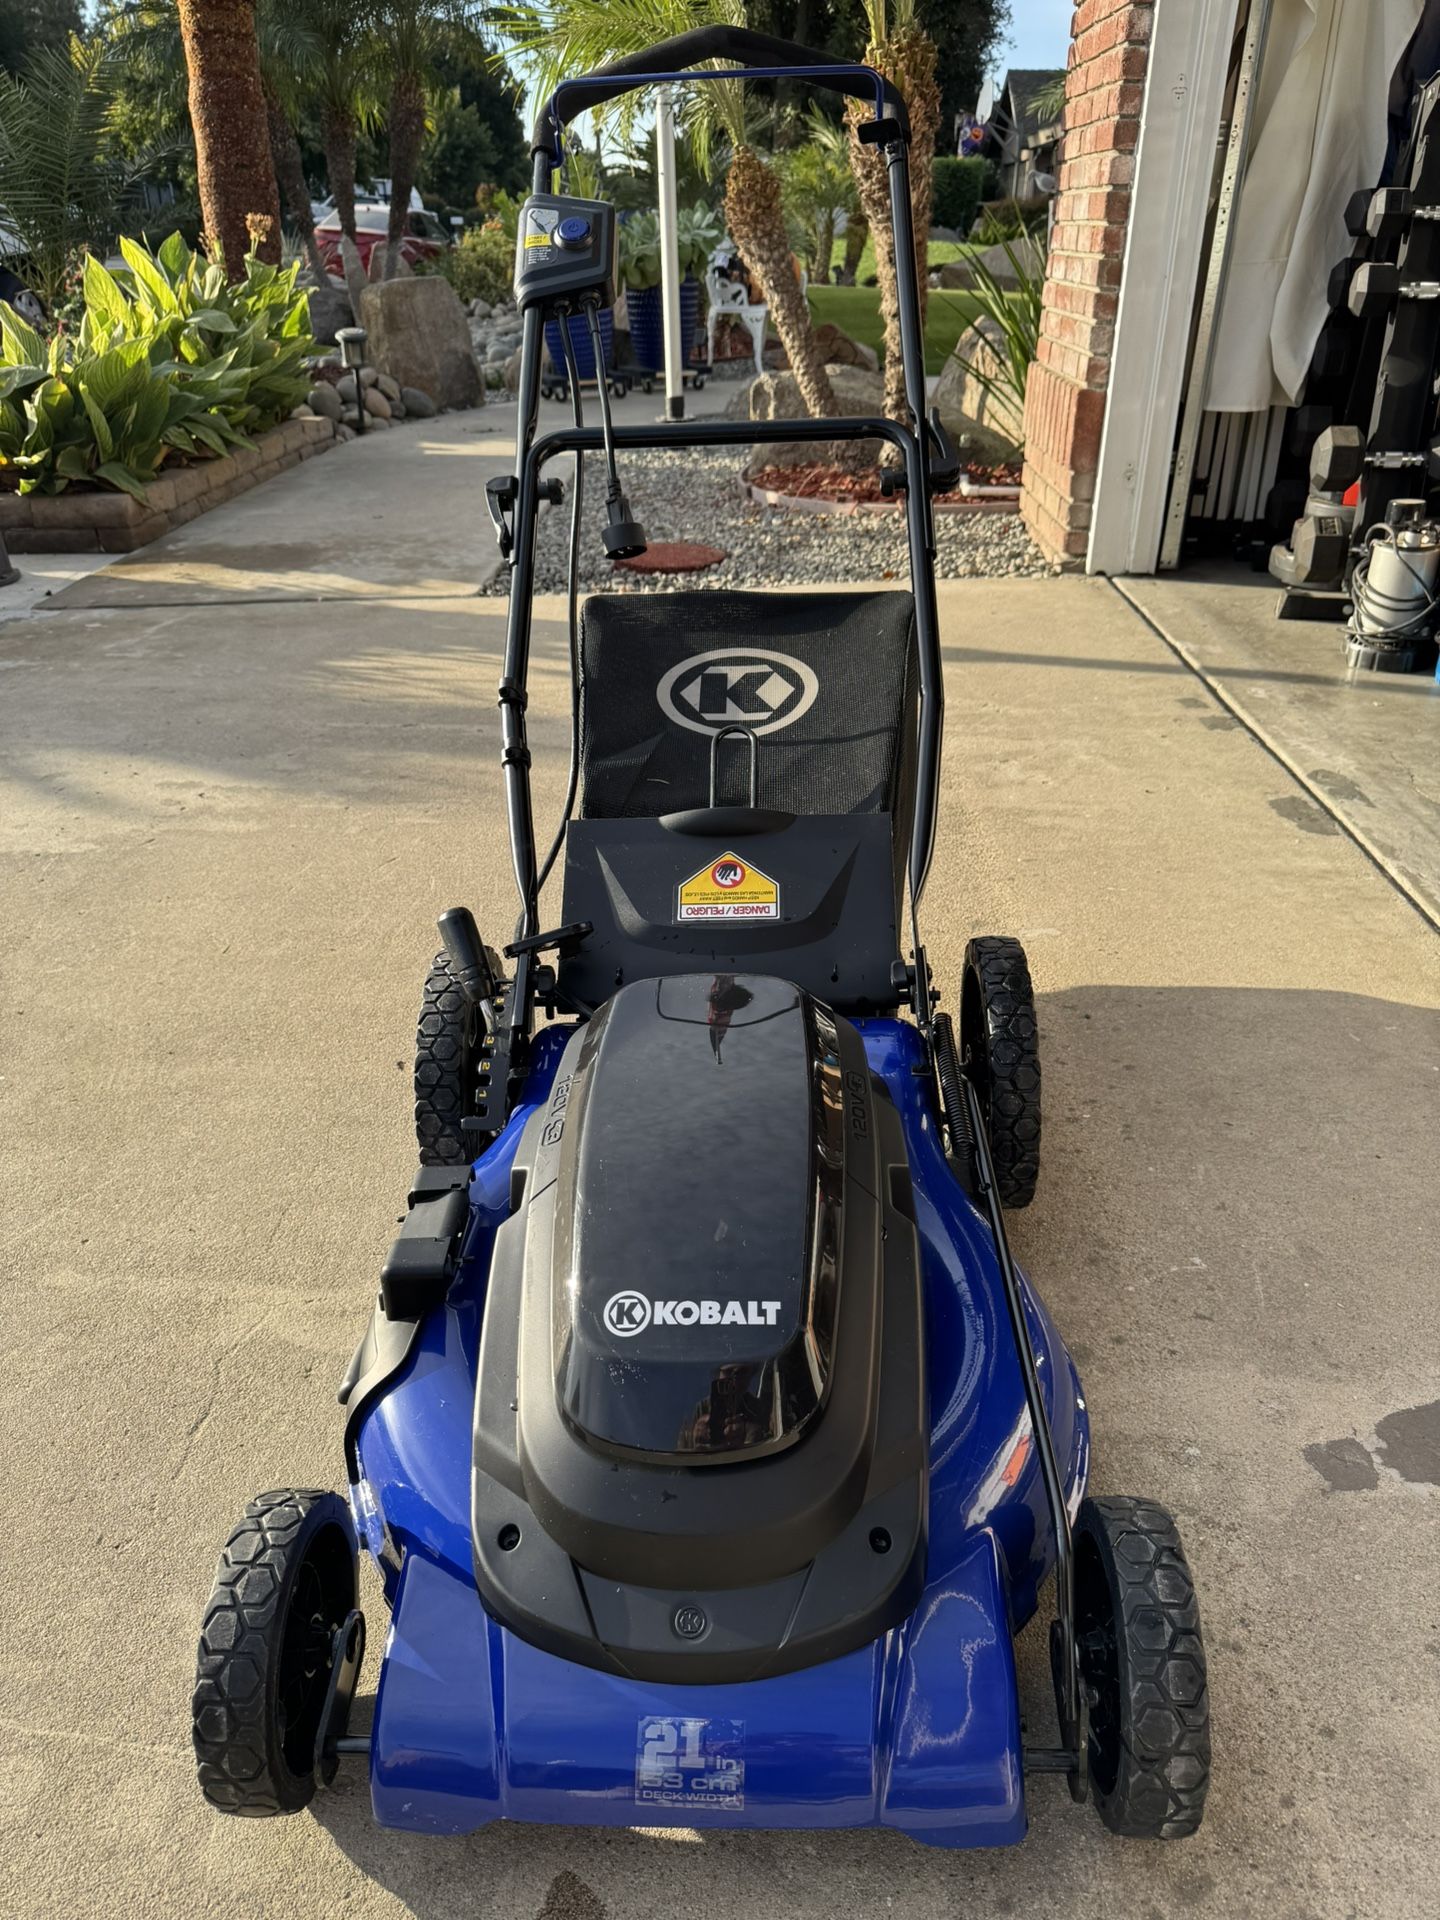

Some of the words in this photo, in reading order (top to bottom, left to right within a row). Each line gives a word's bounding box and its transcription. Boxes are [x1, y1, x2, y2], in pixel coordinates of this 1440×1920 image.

[686, 906, 724, 916] PELIGRO
[733, 905, 770, 914] DANGER
[486, 1036, 495, 1045] 3
[482, 1061, 490, 1070] 2
[479, 1090, 487, 1098] 1
[850, 1092, 867, 1141] 120V
[653, 1300, 781, 1326] KOBALT
[643, 1723, 706, 1769] 21
[716, 1755, 737, 1770] in
[642, 1771, 684, 1789] 53
[691, 1775, 737, 1791] cm
[642, 1790, 683, 1801] DECK
[687, 1792, 737, 1804] WIDTH
